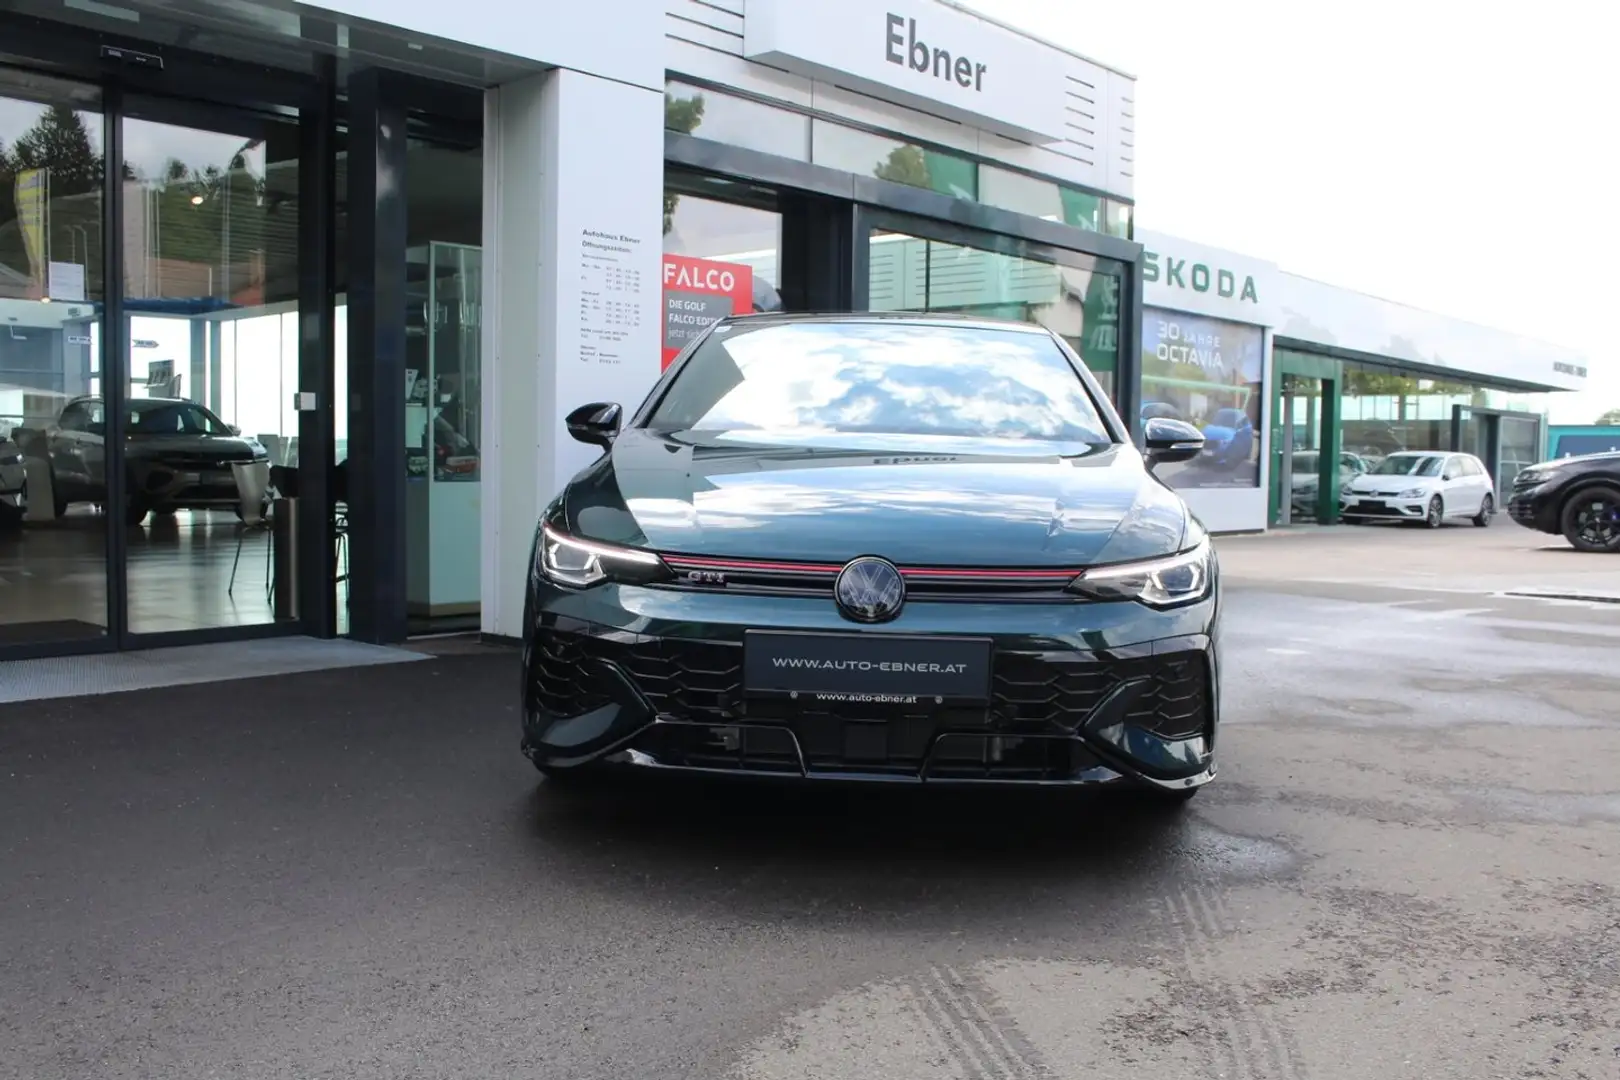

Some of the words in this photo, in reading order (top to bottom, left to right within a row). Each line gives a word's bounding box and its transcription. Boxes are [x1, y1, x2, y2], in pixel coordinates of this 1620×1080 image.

[886, 12, 986, 92] Ebner
[663, 262, 735, 292] FALCO
[669, 299, 682, 309] DIE
[684, 301, 707, 312] GOLF
[669, 313, 696, 325] FALCO
[1156, 320, 1180, 340] 30
[1183, 330, 1221, 348] JAHRE
[1156, 343, 1224, 370] OCTAVIA
[687, 569, 725, 584] GTI
[772, 656, 967, 674] WWW.AUTO-EBNER.AT
[816, 692, 917, 704] www.auto-ebner.at
